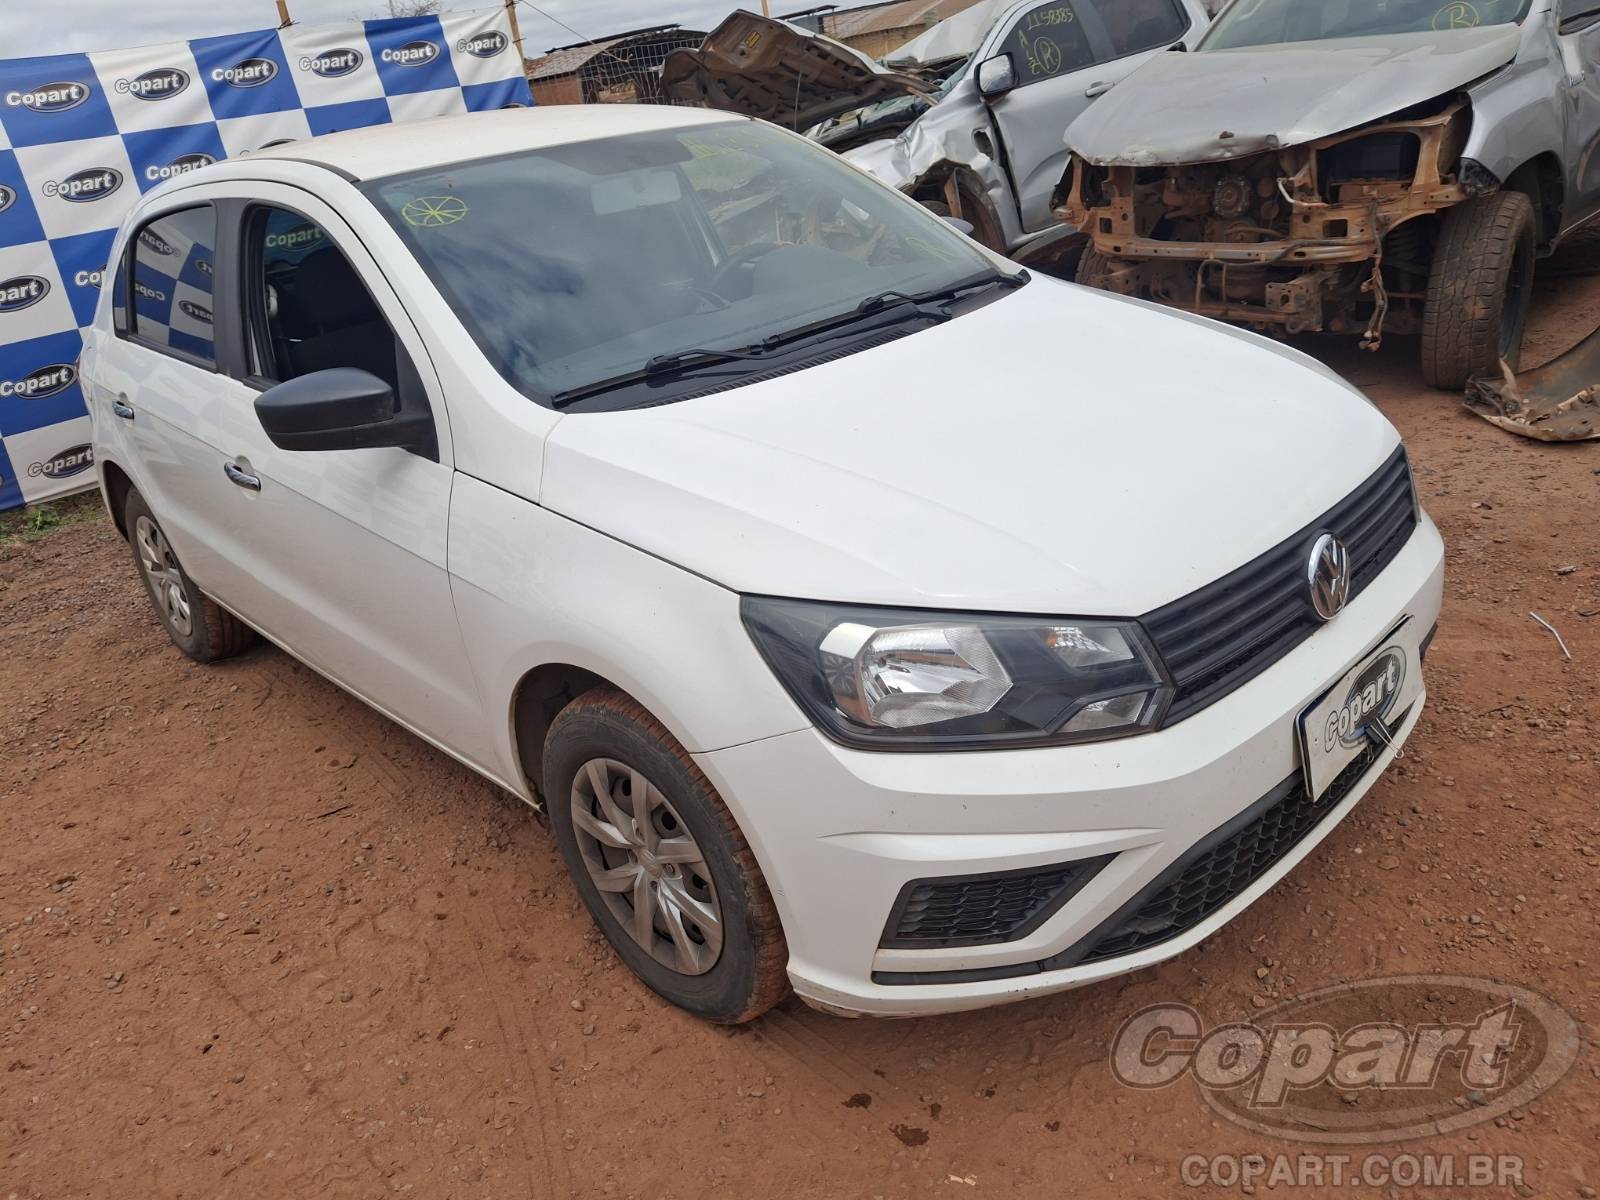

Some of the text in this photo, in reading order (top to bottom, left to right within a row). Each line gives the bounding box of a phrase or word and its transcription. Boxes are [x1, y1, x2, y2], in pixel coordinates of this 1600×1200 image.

[381, 45, 433, 61] Copart
[457, 35, 501, 54] Copart
[211, 62, 270, 82] Copart
[299, 52, 354, 73] Copart
[115, 72, 180, 95] Copart
[6, 84, 79, 106] Copart
[146, 158, 208, 180] Copart
[42, 172, 113, 198] Copart
[265, 226, 322, 248] Copart
[0, 367, 69, 396] Copart
[28, 449, 93, 477] Copart
[1324, 655, 1396, 753] Copart
